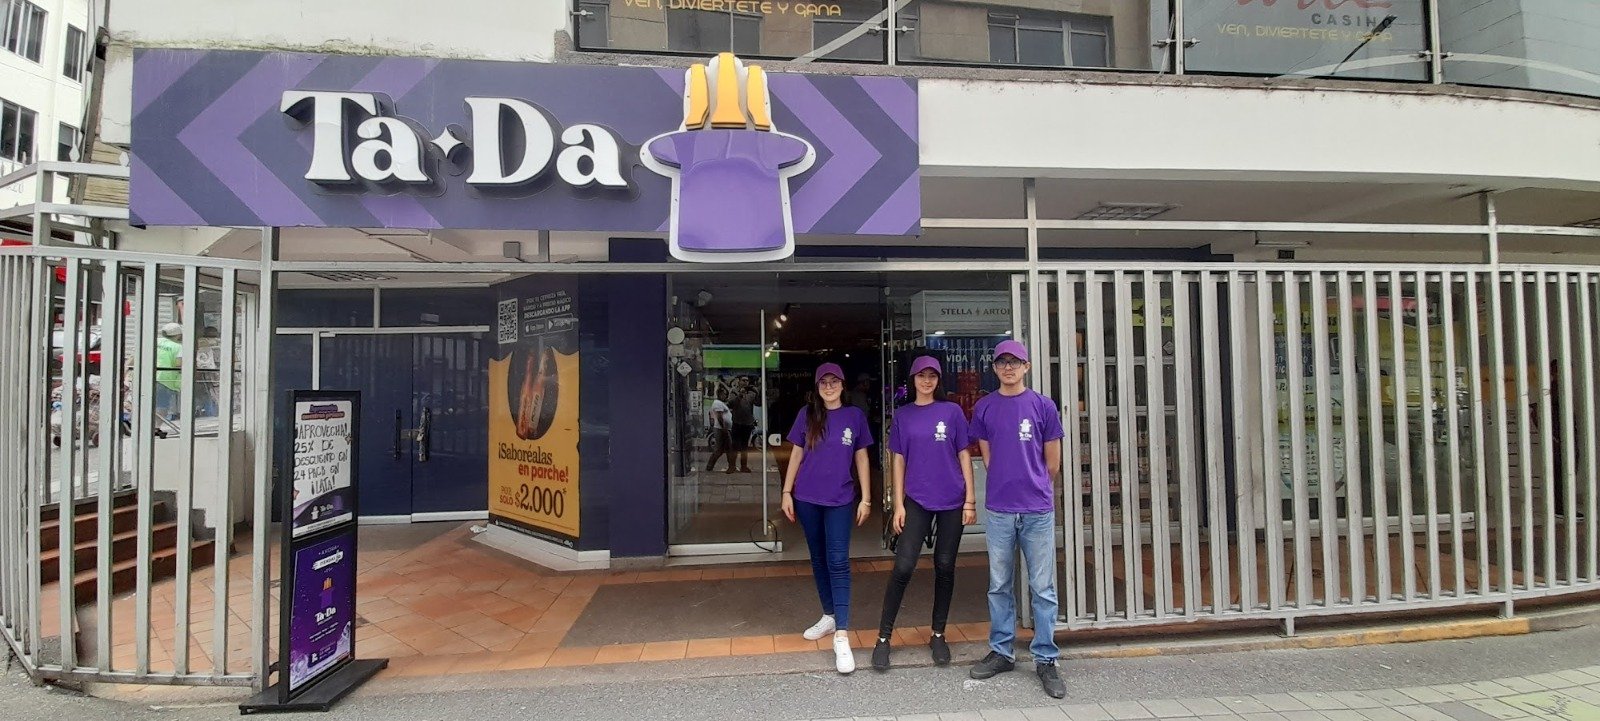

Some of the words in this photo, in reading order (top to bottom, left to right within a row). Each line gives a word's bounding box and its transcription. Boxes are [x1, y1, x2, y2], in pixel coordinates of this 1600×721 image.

[669, 0, 773, 14] DIVIERTETE
[777, 2, 789, 15] Y
[794, 3, 842, 18] GANA
[1216, 23, 1251, 38] VEN,
[1256, 24, 1339, 41] DIVIERTETE
[280, 89, 429, 183] Ta
[464, 95, 628, 188] Da
[560, 304, 571, 312] APP
[940, 308, 972, 316] STELLA
[946, 354, 968, 363] VIDA
[294, 440, 314, 454] 25%
[321, 439, 334, 452] DE
[498, 442, 553, 466] ¡Saboréalas
[338, 449, 348, 463] EN
[294, 470, 306, 481] 24
[329, 462, 340, 475] EN
[518, 465, 529, 476] en
[531, 464, 569, 484] parche!
[499, 494, 513, 506] SOLO
